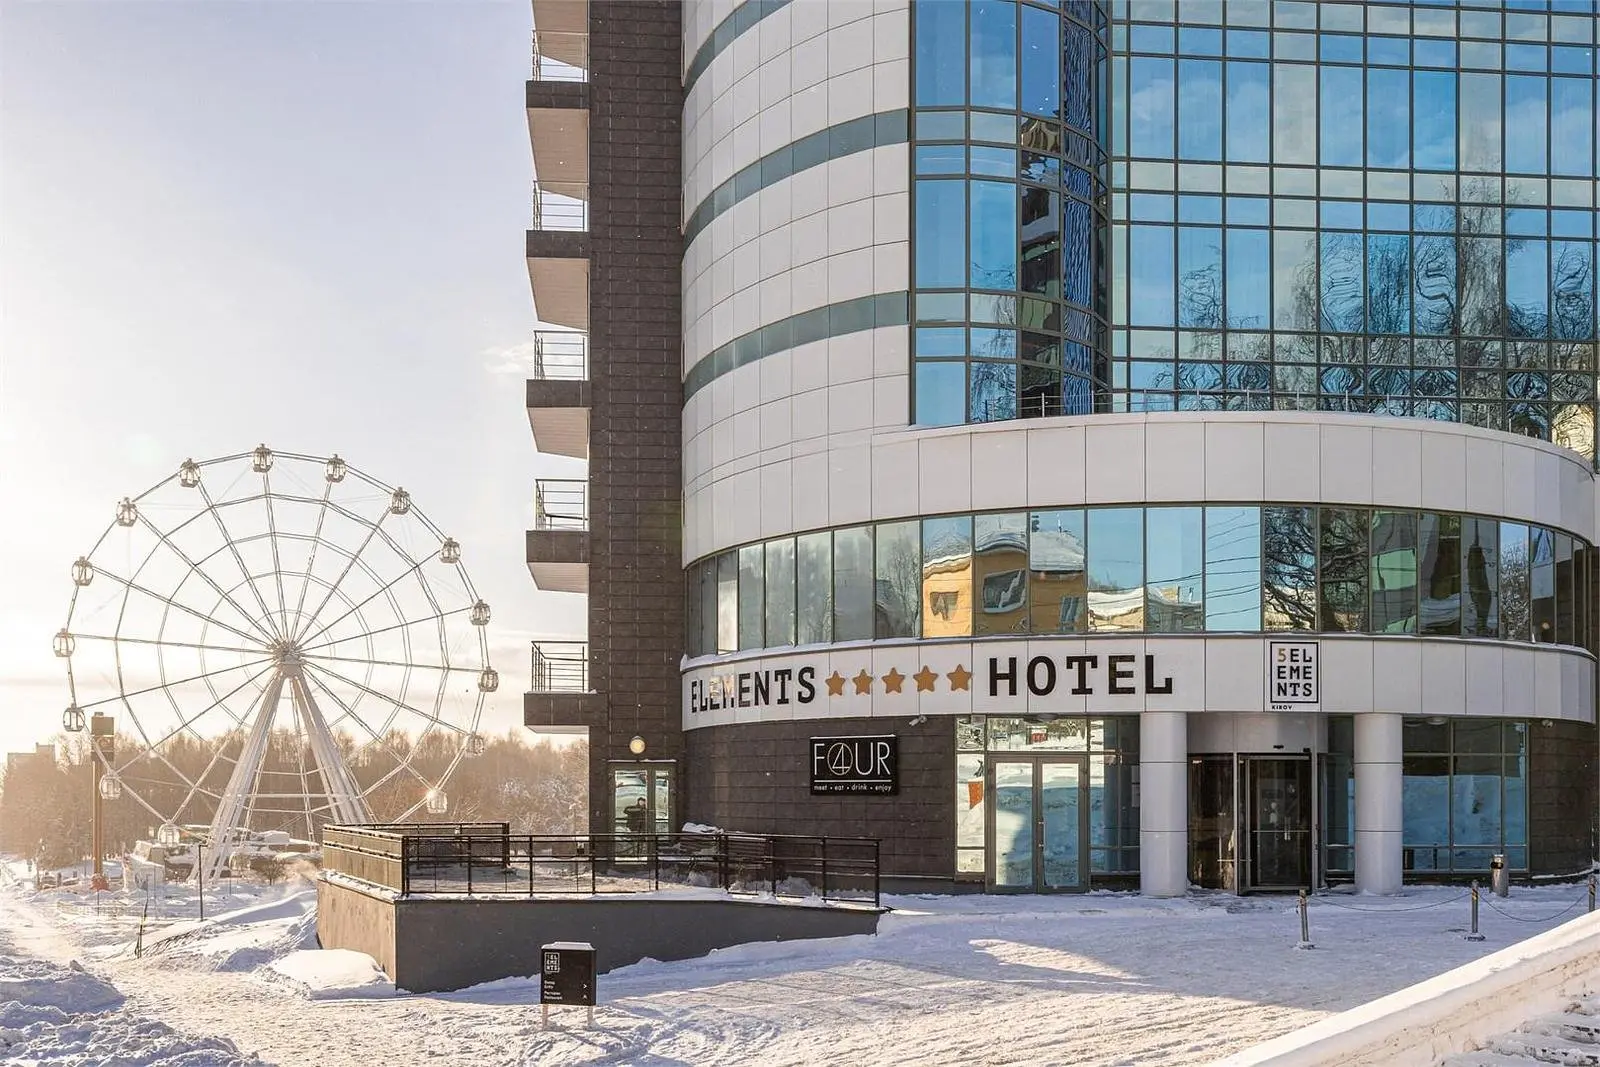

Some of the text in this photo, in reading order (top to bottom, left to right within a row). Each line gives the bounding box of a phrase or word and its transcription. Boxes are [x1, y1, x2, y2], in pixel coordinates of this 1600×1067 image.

[1277, 647, 1313, 663] 5EL
[1277, 665, 1313, 680] EME
[691, 654, 1173, 714] ELEMENTS HOTEL
[1277, 682, 1313, 697] NTS
[851, 783, 867, 791] drink
[874, 784, 892, 793] enjoy
